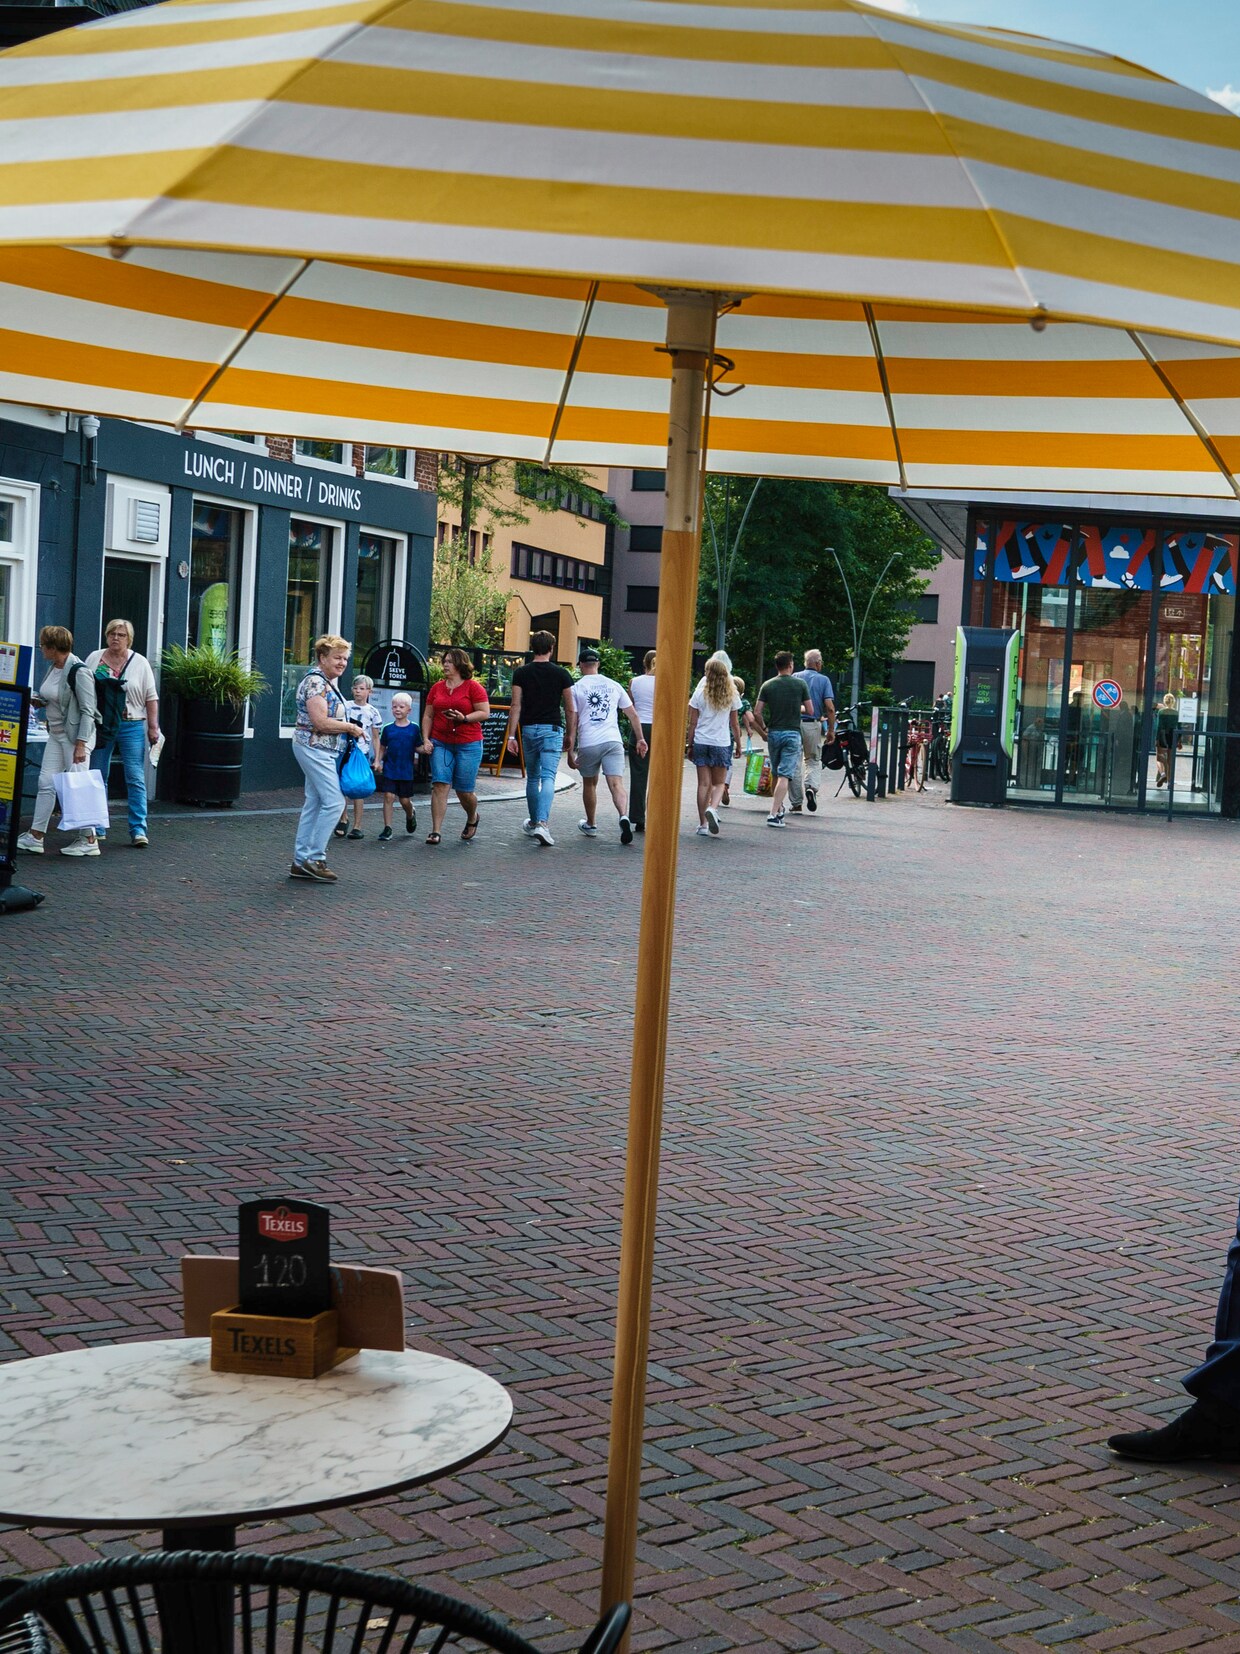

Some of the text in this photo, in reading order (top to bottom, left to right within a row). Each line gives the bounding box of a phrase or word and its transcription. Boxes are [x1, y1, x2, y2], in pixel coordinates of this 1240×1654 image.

[184, 450, 235, 485] LUNCH
[253, 467, 303, 499] DINNER
[318, 481, 362, 511] DRINKS
[977, 682, 991, 690] Free
[977, 690, 990, 698] city
[261, 1215, 305, 1233] TEXELS
[253, 1254, 307, 1287] 120
[226, 1327, 296, 1356] TEXELS
